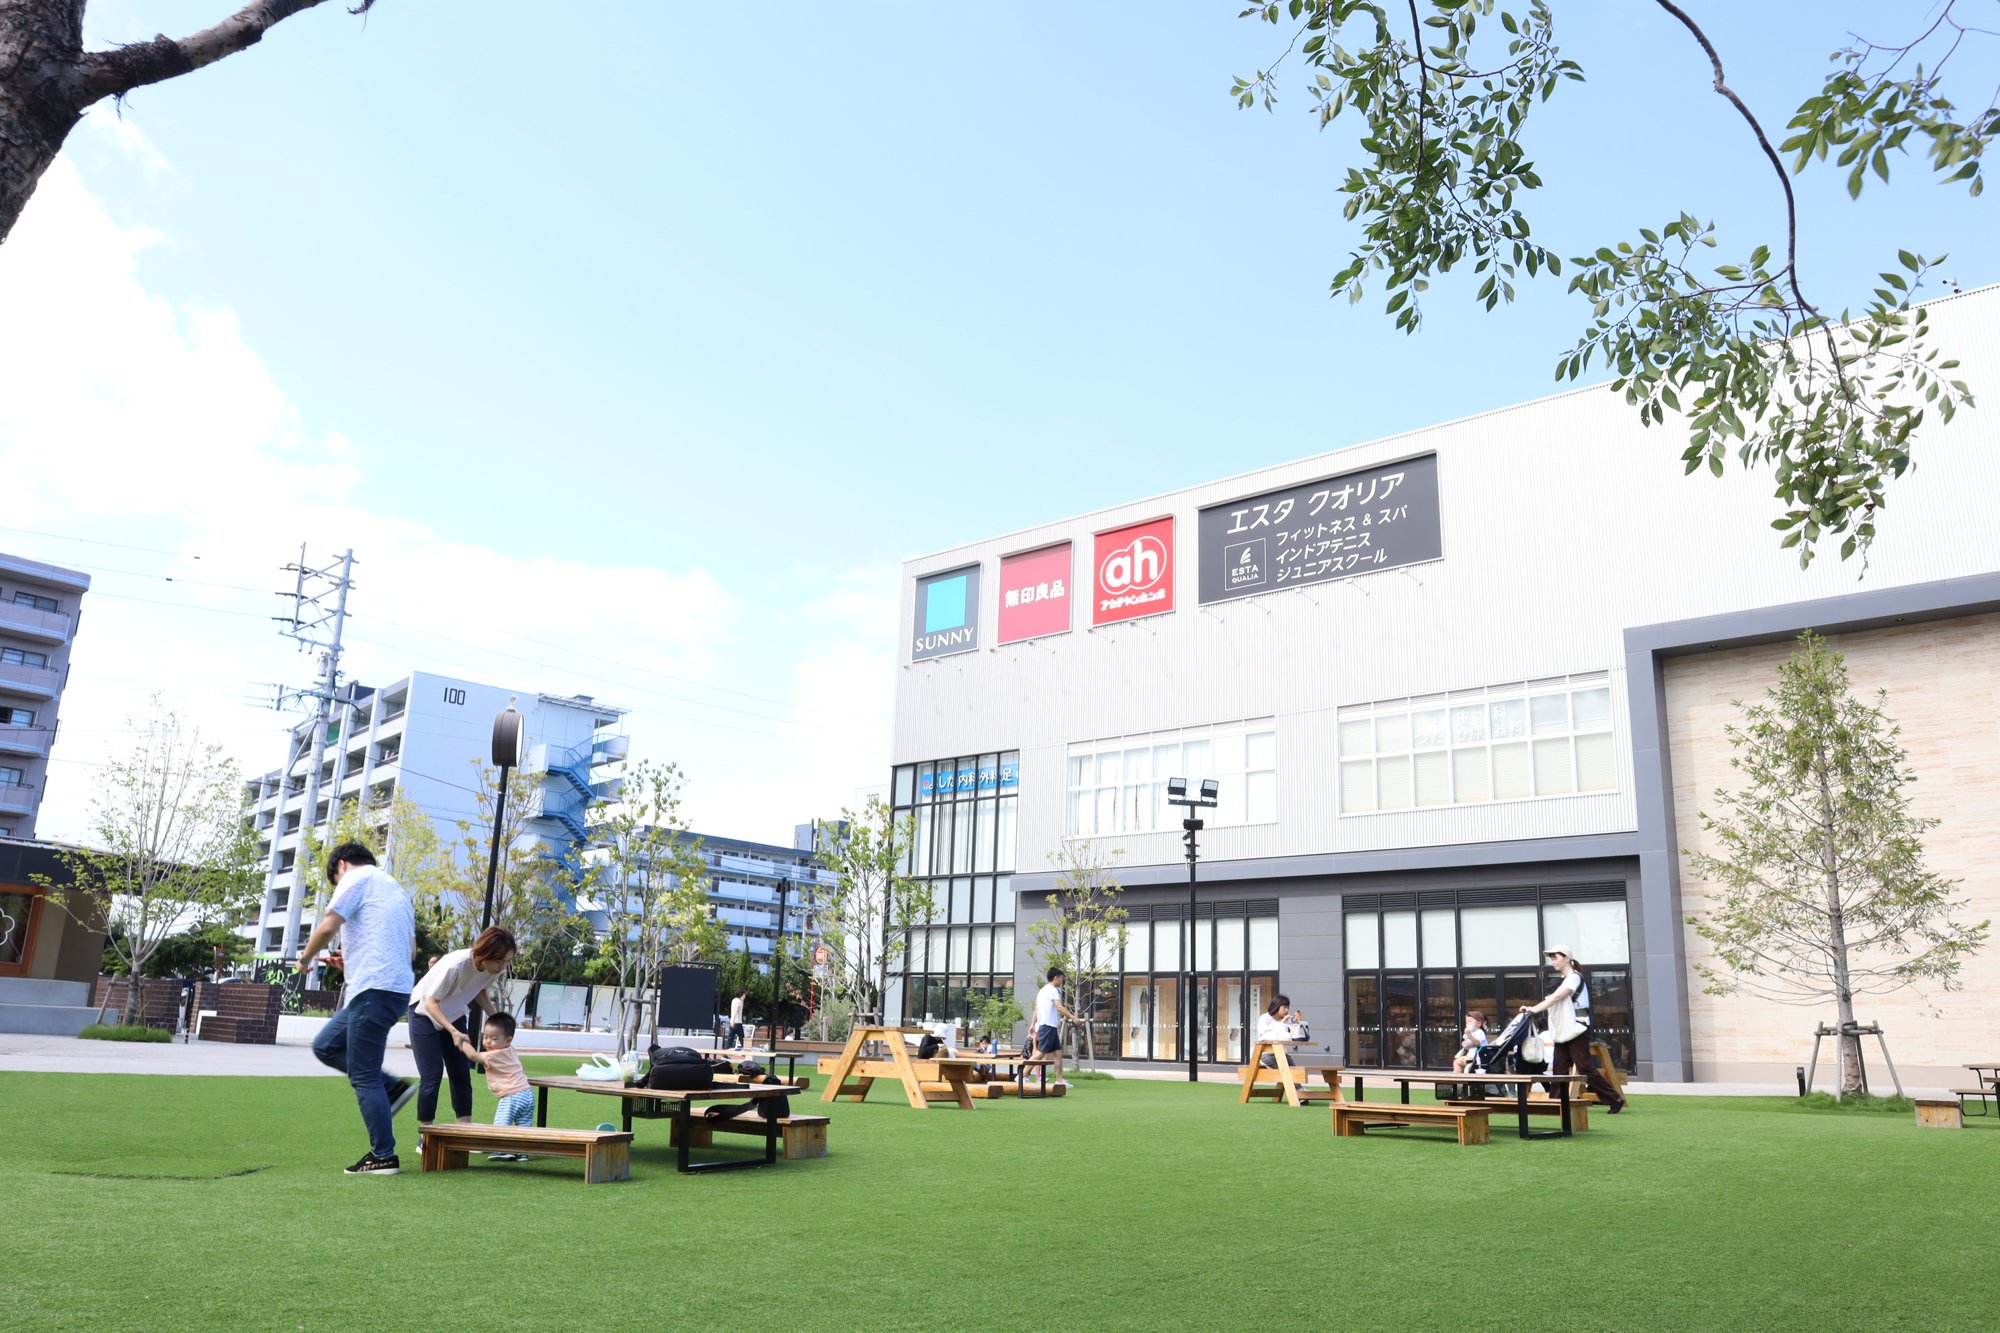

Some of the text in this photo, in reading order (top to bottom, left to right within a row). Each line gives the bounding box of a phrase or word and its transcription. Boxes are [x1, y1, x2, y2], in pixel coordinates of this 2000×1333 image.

[1227, 472, 1405, 534] エスタ クオリア
[1276, 504, 1408, 546] フィットネス & スパ
[1276, 533, 1371, 564] インドアテニス
[1105, 540, 1158, 588] ah
[1232, 564, 1259, 577] ESTA
[1232, 574, 1259, 584] QUALIA
[1276, 548, 1387, 582] ジュニアスクール
[1005, 579, 1065, 608] 無印良品
[915, 626, 974, 652] SUNNY
[443, 687, 466, 706] 100
